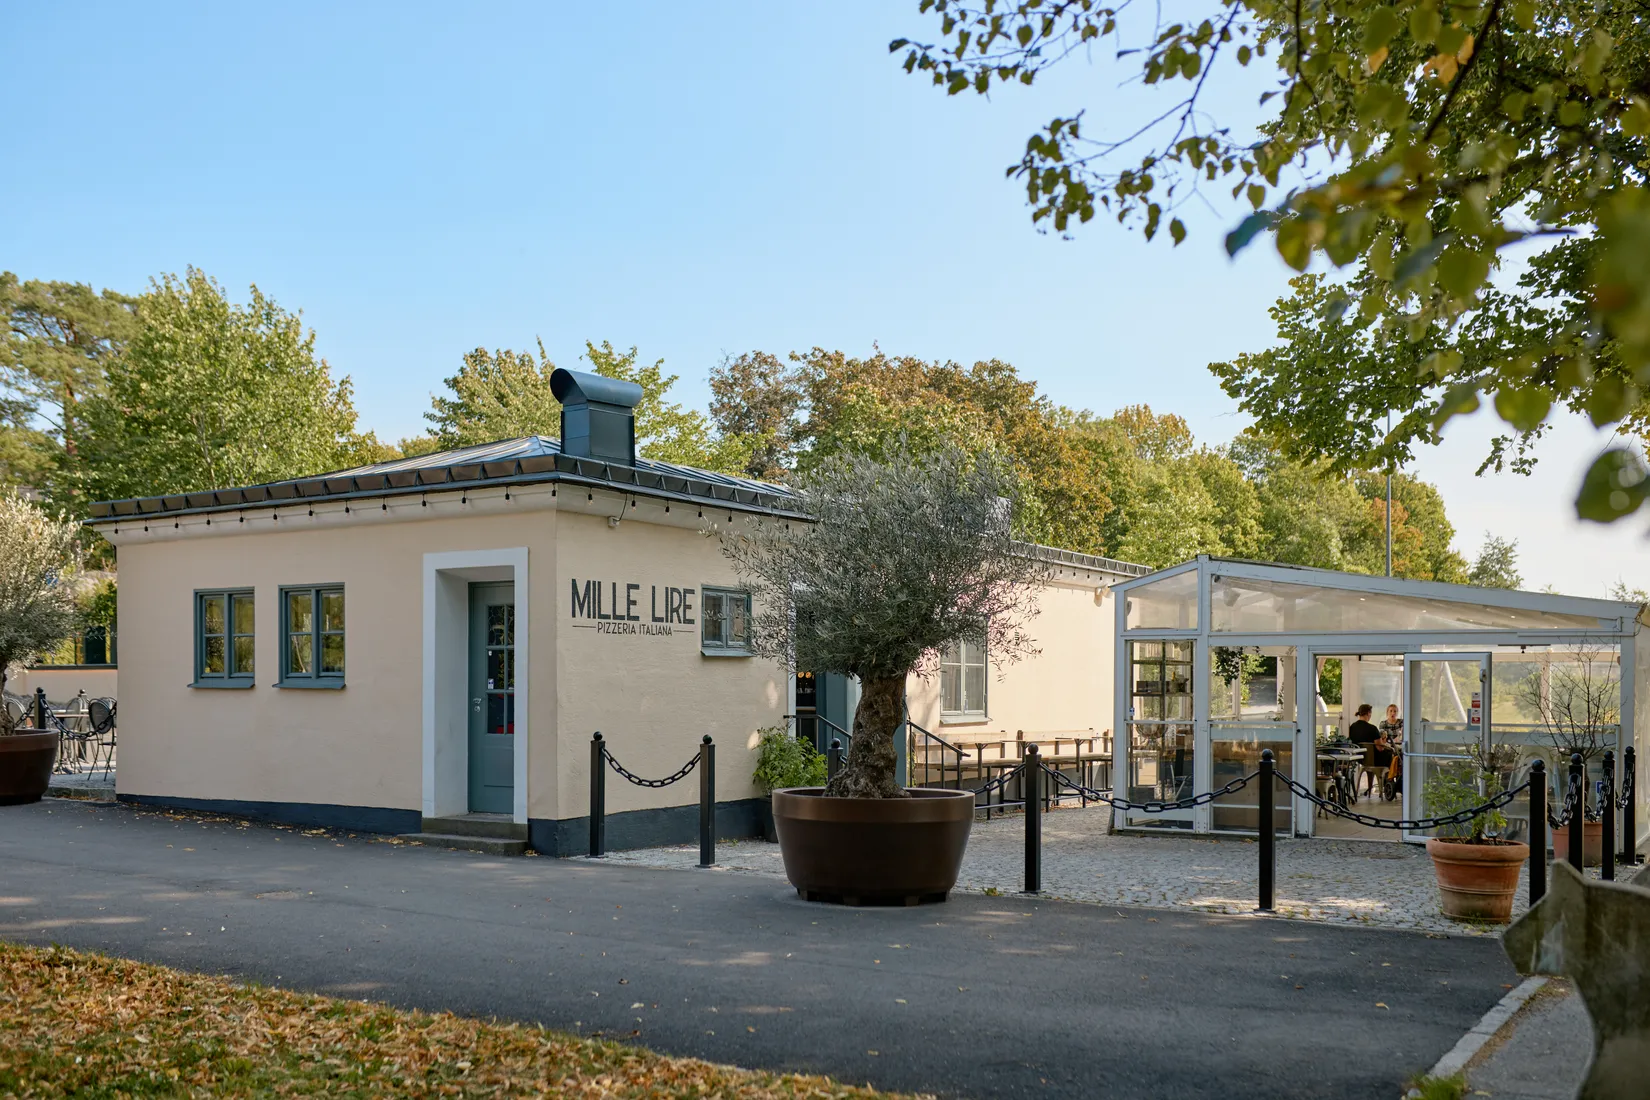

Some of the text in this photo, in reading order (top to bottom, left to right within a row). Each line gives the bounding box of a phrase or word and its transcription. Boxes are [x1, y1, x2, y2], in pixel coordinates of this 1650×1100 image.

[571, 579, 695, 624] MILLE LIRE
[597, 621, 673, 636] PIZZERIA ITALIANA
